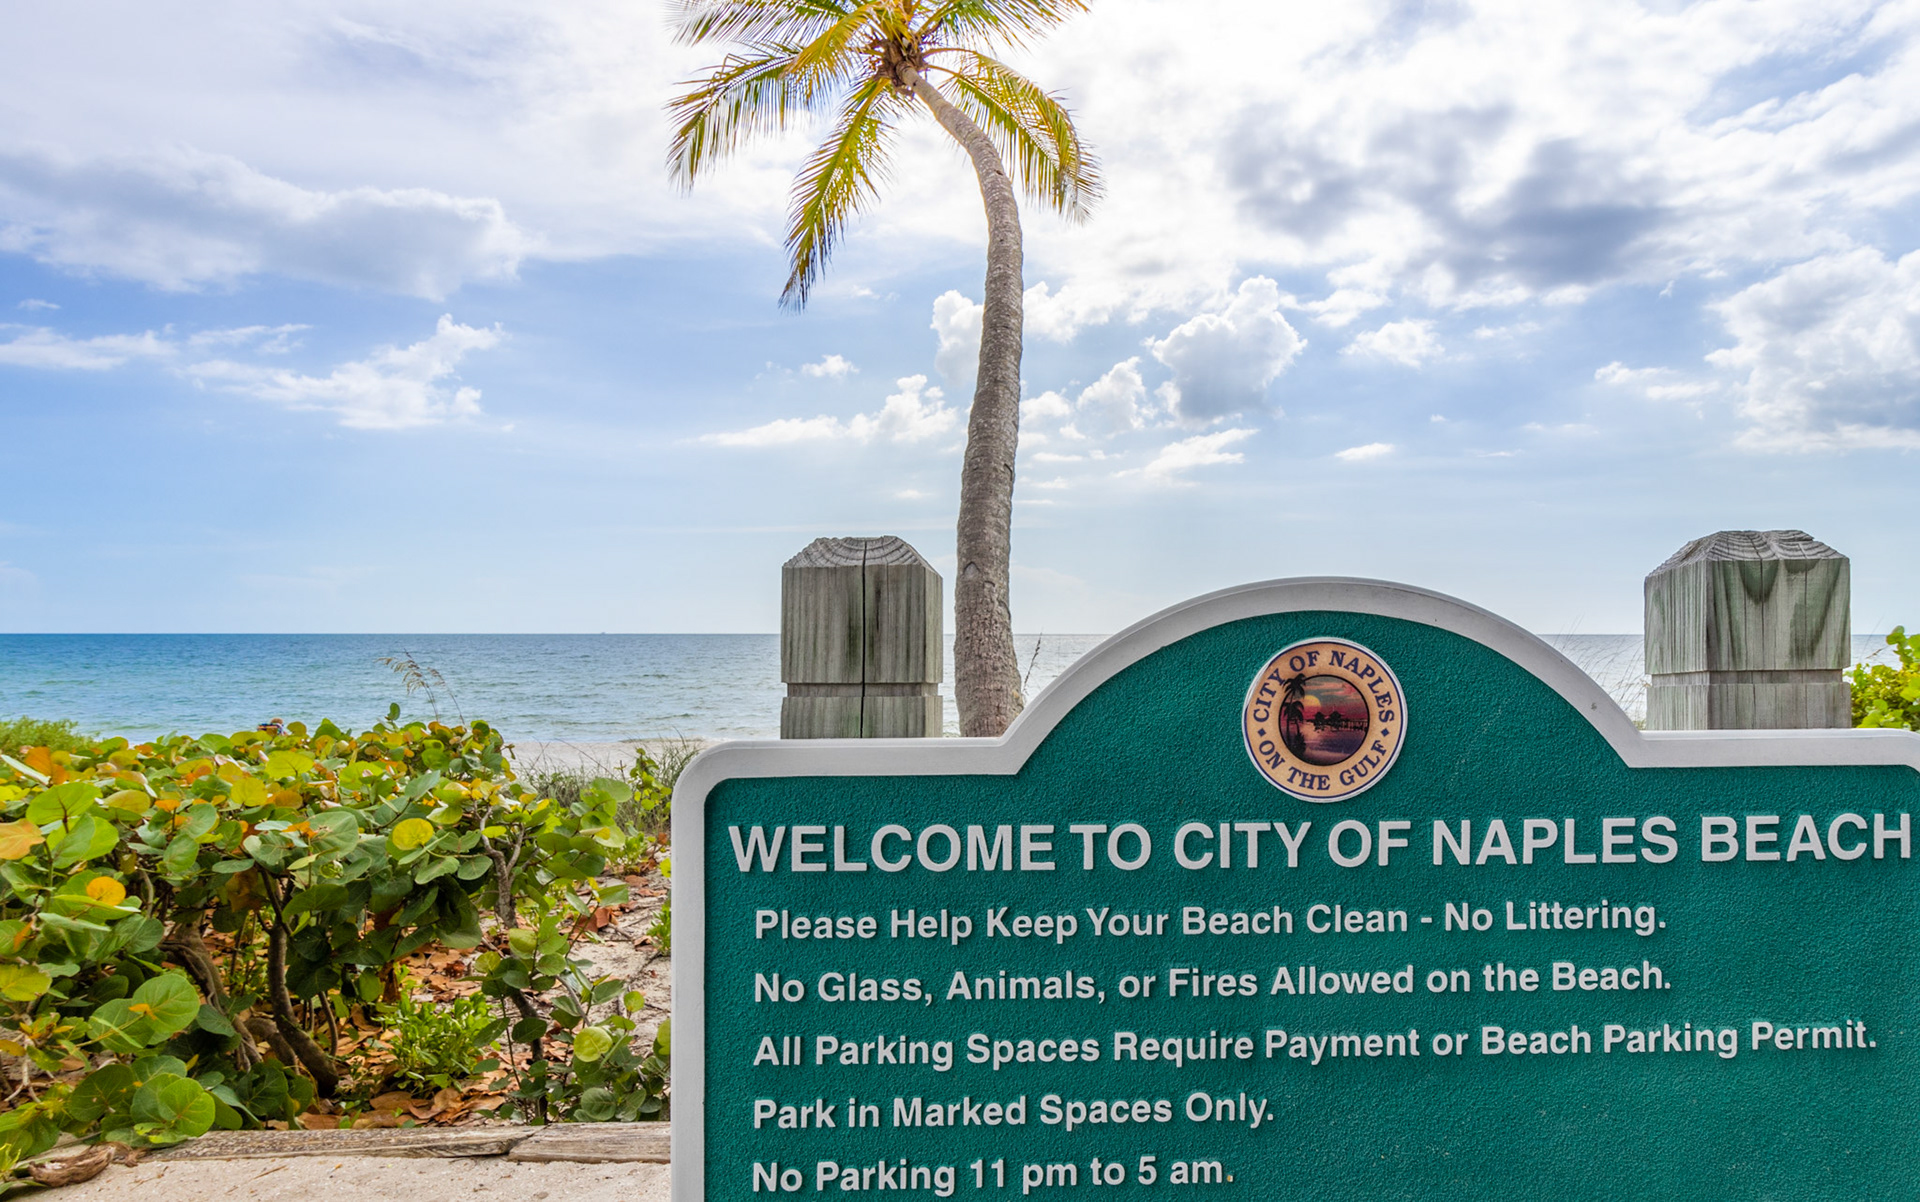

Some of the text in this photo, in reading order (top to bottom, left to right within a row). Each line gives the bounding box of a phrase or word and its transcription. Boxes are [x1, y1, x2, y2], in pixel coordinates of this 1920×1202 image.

[1253, 650, 1395, 723] CITY OF NAPLES
[1258, 739, 1387, 791] ON THE GULF
[727, 812, 1911, 873] WELCOME TO CITY OF NAPLES BEACH
[755, 909, 877, 940] Please
[890, 908, 972, 946] Help
[986, 906, 1078, 945] Keep
[1085, 907, 1169, 936] Your
[1182, 905, 1293, 935] Beach
[1306, 903, 1408, 934] Clean
[1444, 902, 1493, 932] No
[1505, 898, 1666, 937] Littering.
[754, 959, 1671, 1007] No Glass, Animals, or Fires Allowed on the Beach.
[752, 1019, 1877, 1072] All Parking Spaces Require Payment or Beach Parking Permit.
[753, 1091, 1274, 1132] Park in Marked Spaces Only.
[752, 1155, 1234, 1198] No Parking 11 pm to 5 am.
